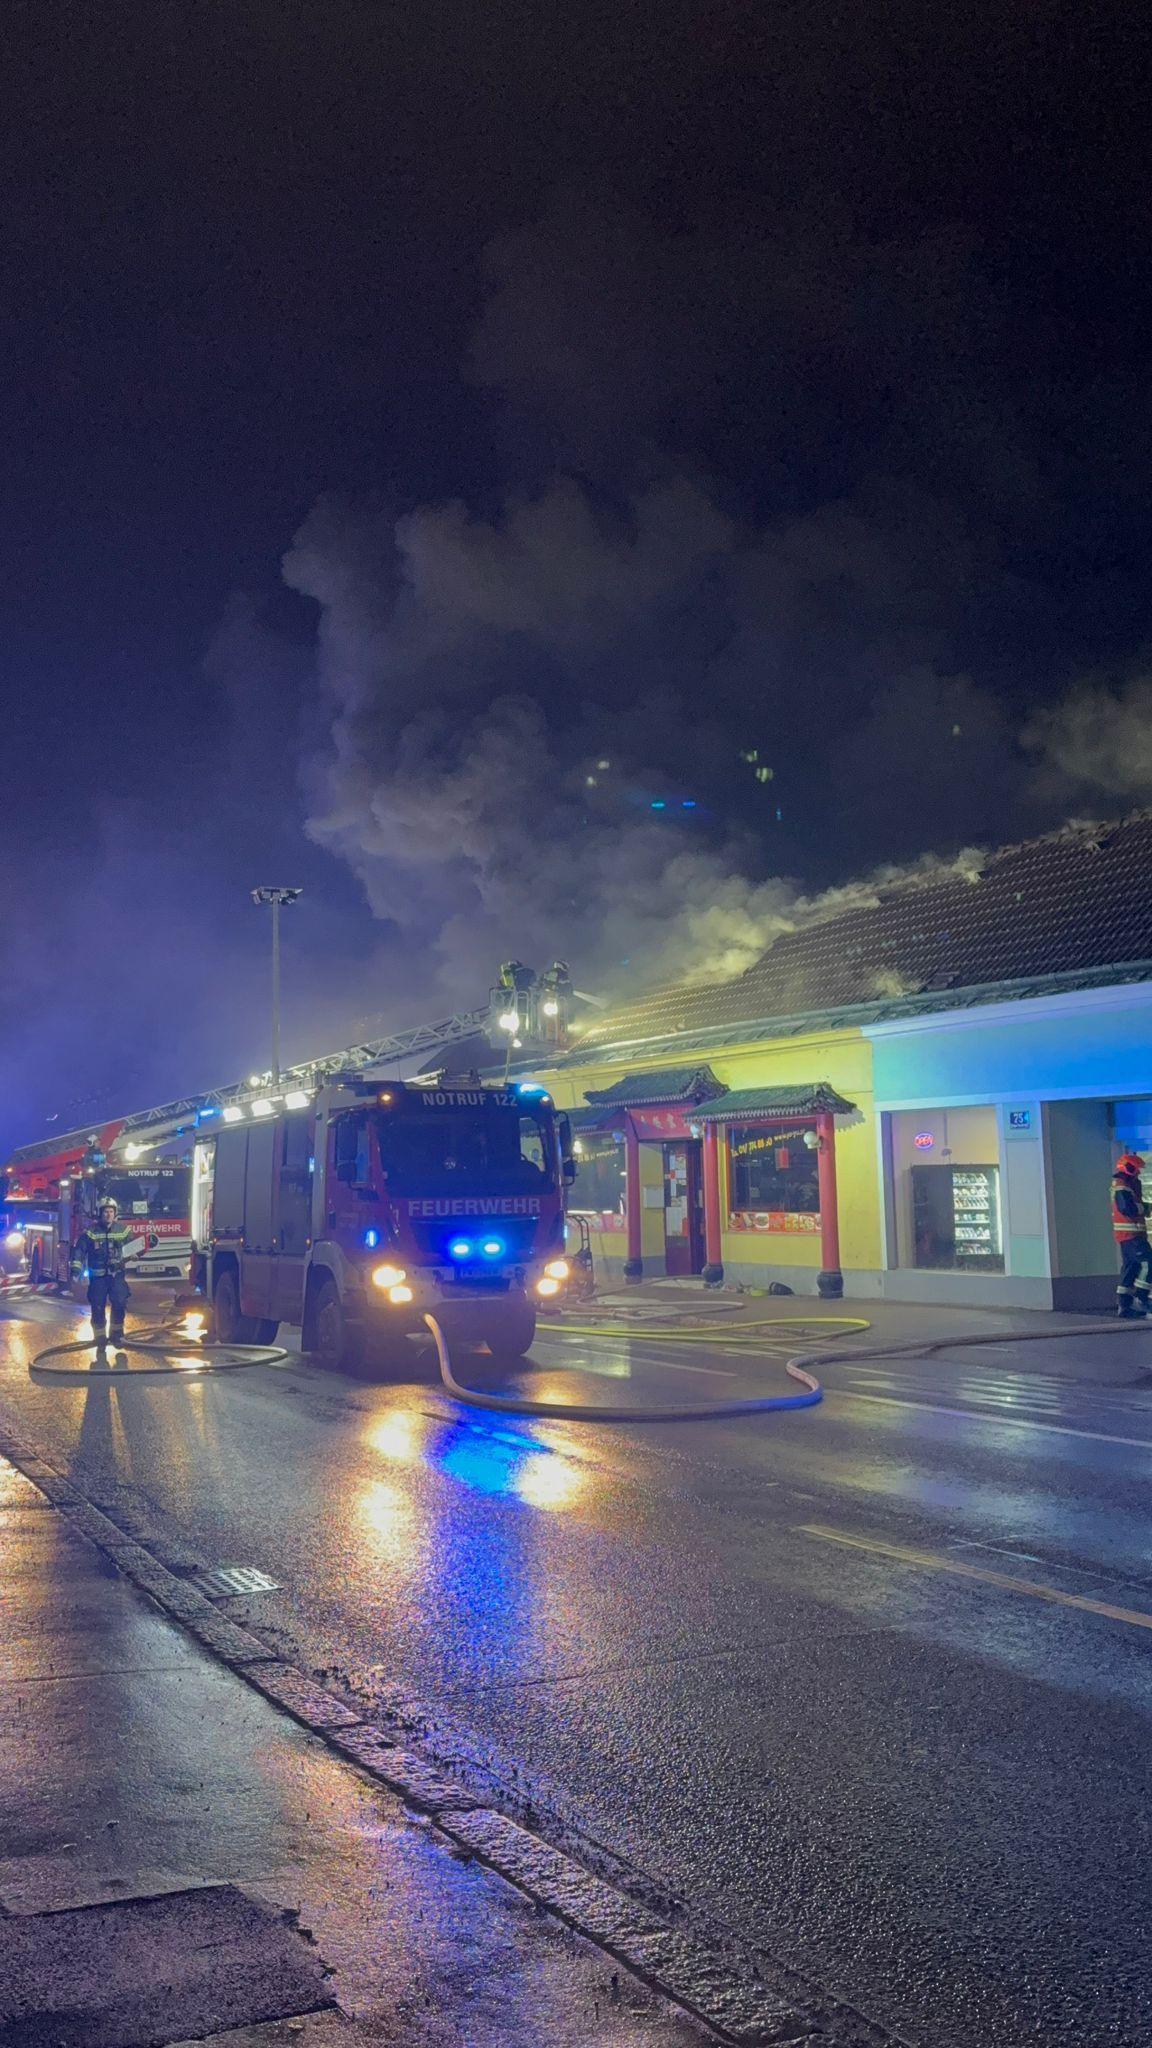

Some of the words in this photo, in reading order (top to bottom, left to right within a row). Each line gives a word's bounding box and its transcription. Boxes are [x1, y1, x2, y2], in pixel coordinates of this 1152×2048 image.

[422, 1092, 487, 1106] NOTRUF
[493, 1094, 518, 1107] 122
[1013, 1112, 1024, 1124] 75
[408, 1198, 541, 1217] FEUERWEHR
